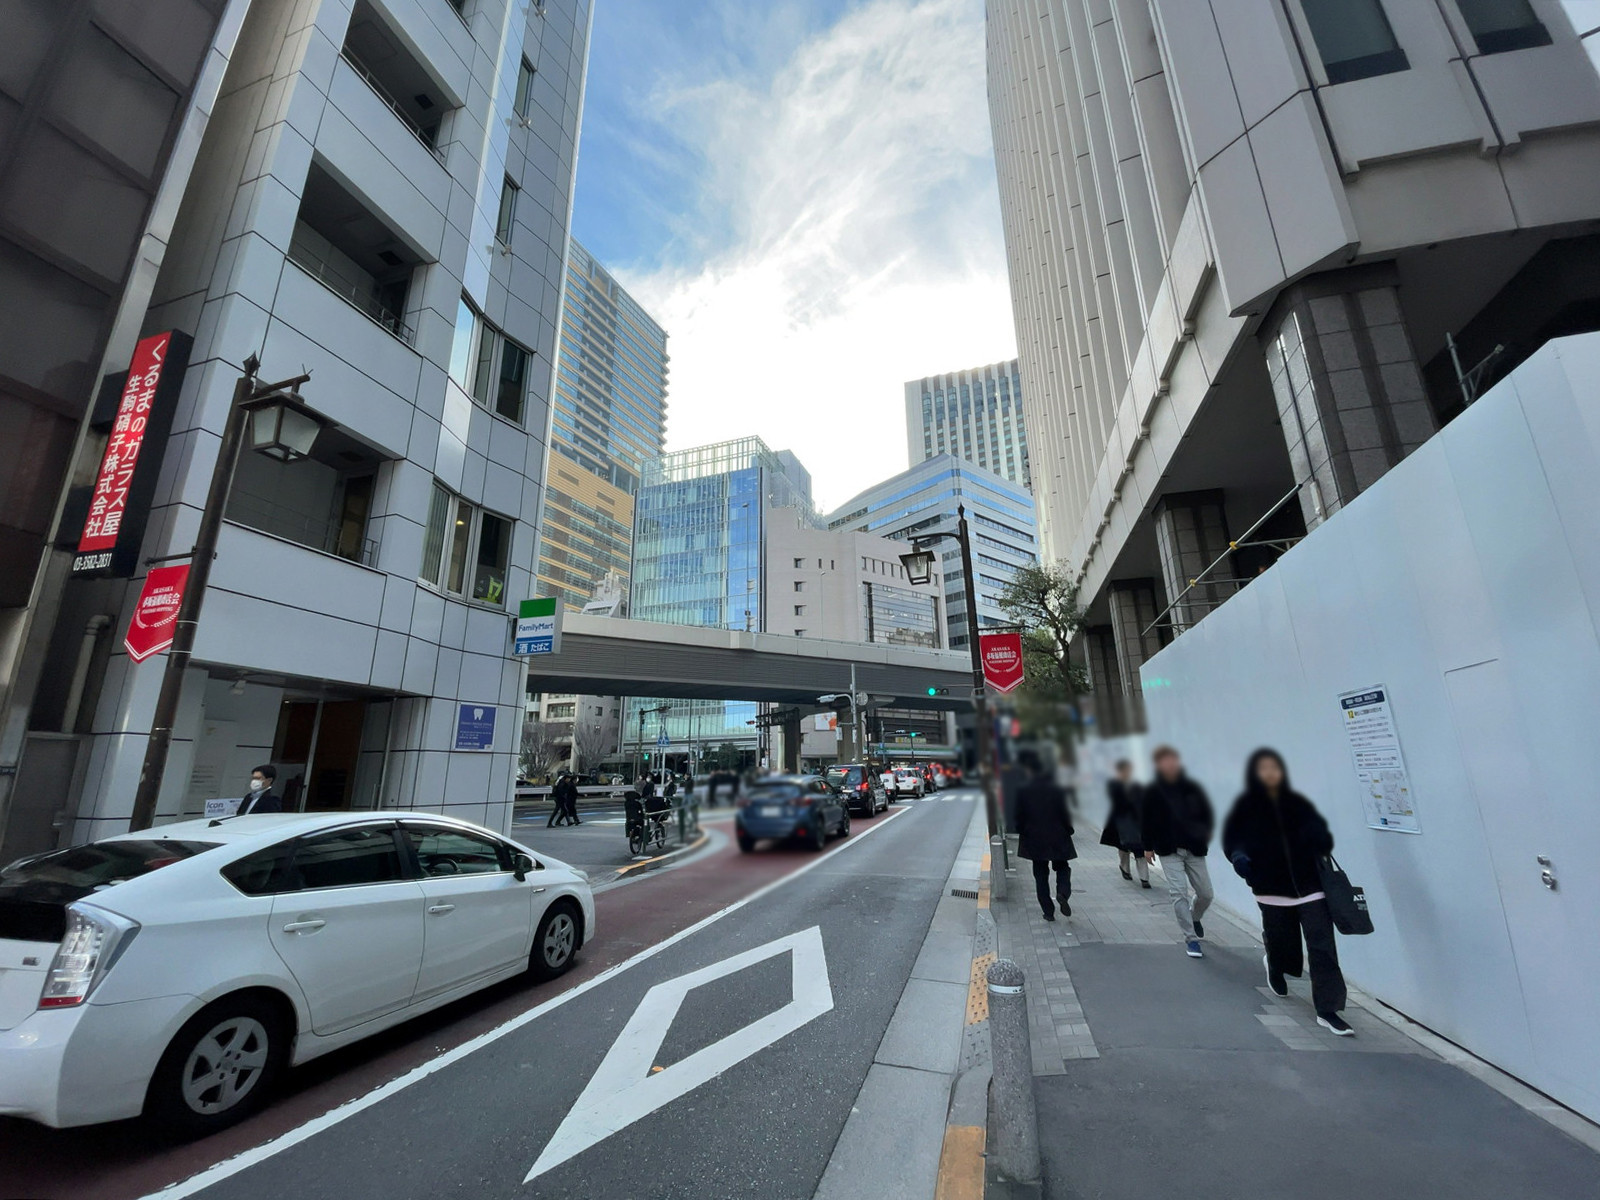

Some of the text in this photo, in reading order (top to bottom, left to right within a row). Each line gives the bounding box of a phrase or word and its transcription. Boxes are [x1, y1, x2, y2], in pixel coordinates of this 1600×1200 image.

[85, 374, 142, 538] 生駒硝子株式会社
[100, 339, 166, 536] くるまのガラス屋
[518, 622, 554, 632] FamilyMart
[518, 642, 550, 654] 酒 たばこ
